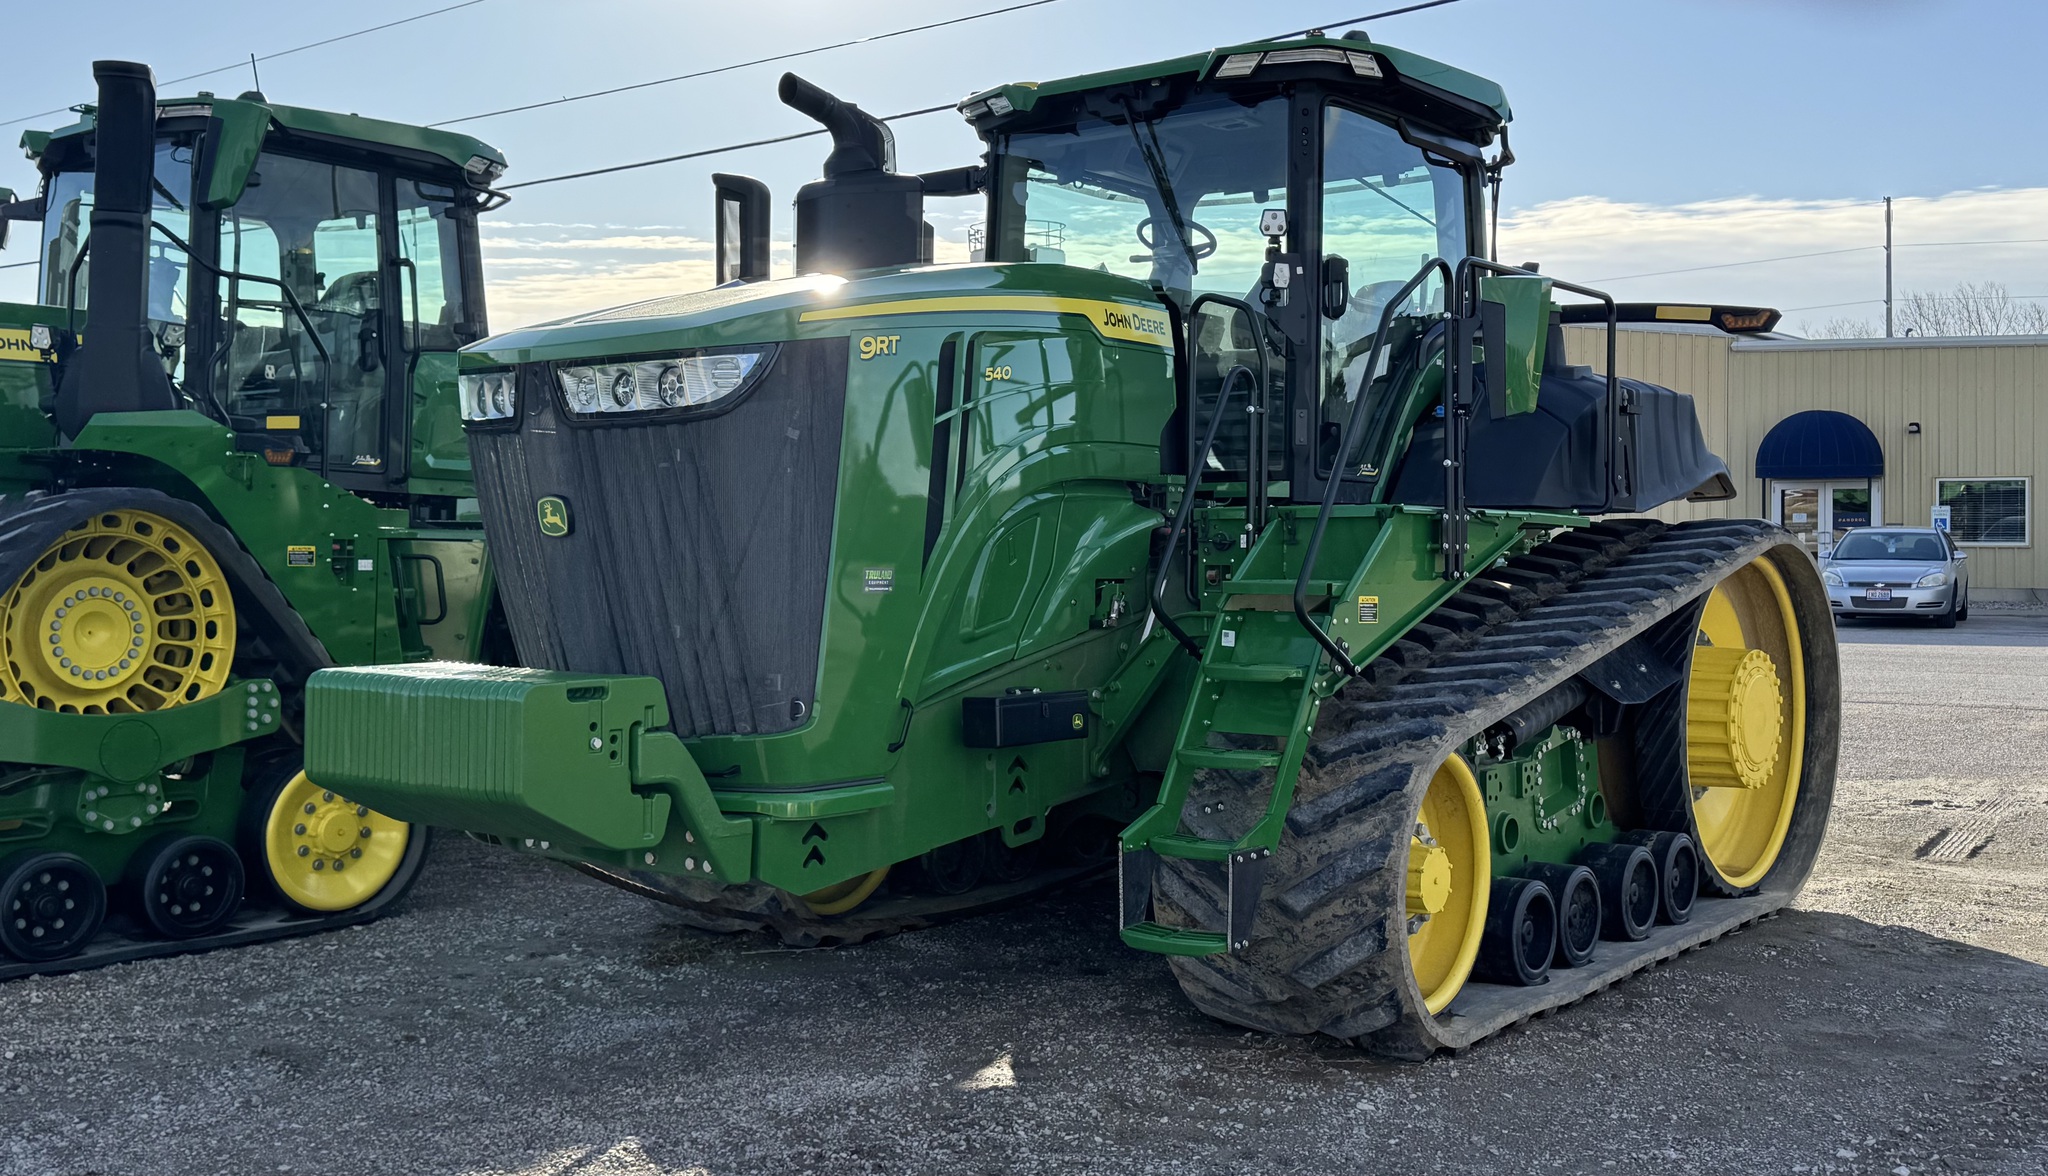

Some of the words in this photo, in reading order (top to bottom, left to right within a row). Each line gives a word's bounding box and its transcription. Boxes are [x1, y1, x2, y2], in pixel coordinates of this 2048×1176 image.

[1103, 308, 1132, 330] JOHN
[1132, 313, 1166, 336] DEERE
[860, 335, 901, 360] 9RT
[985, 365, 1012, 382] 540
[865, 570, 893, 580] TRULAND
